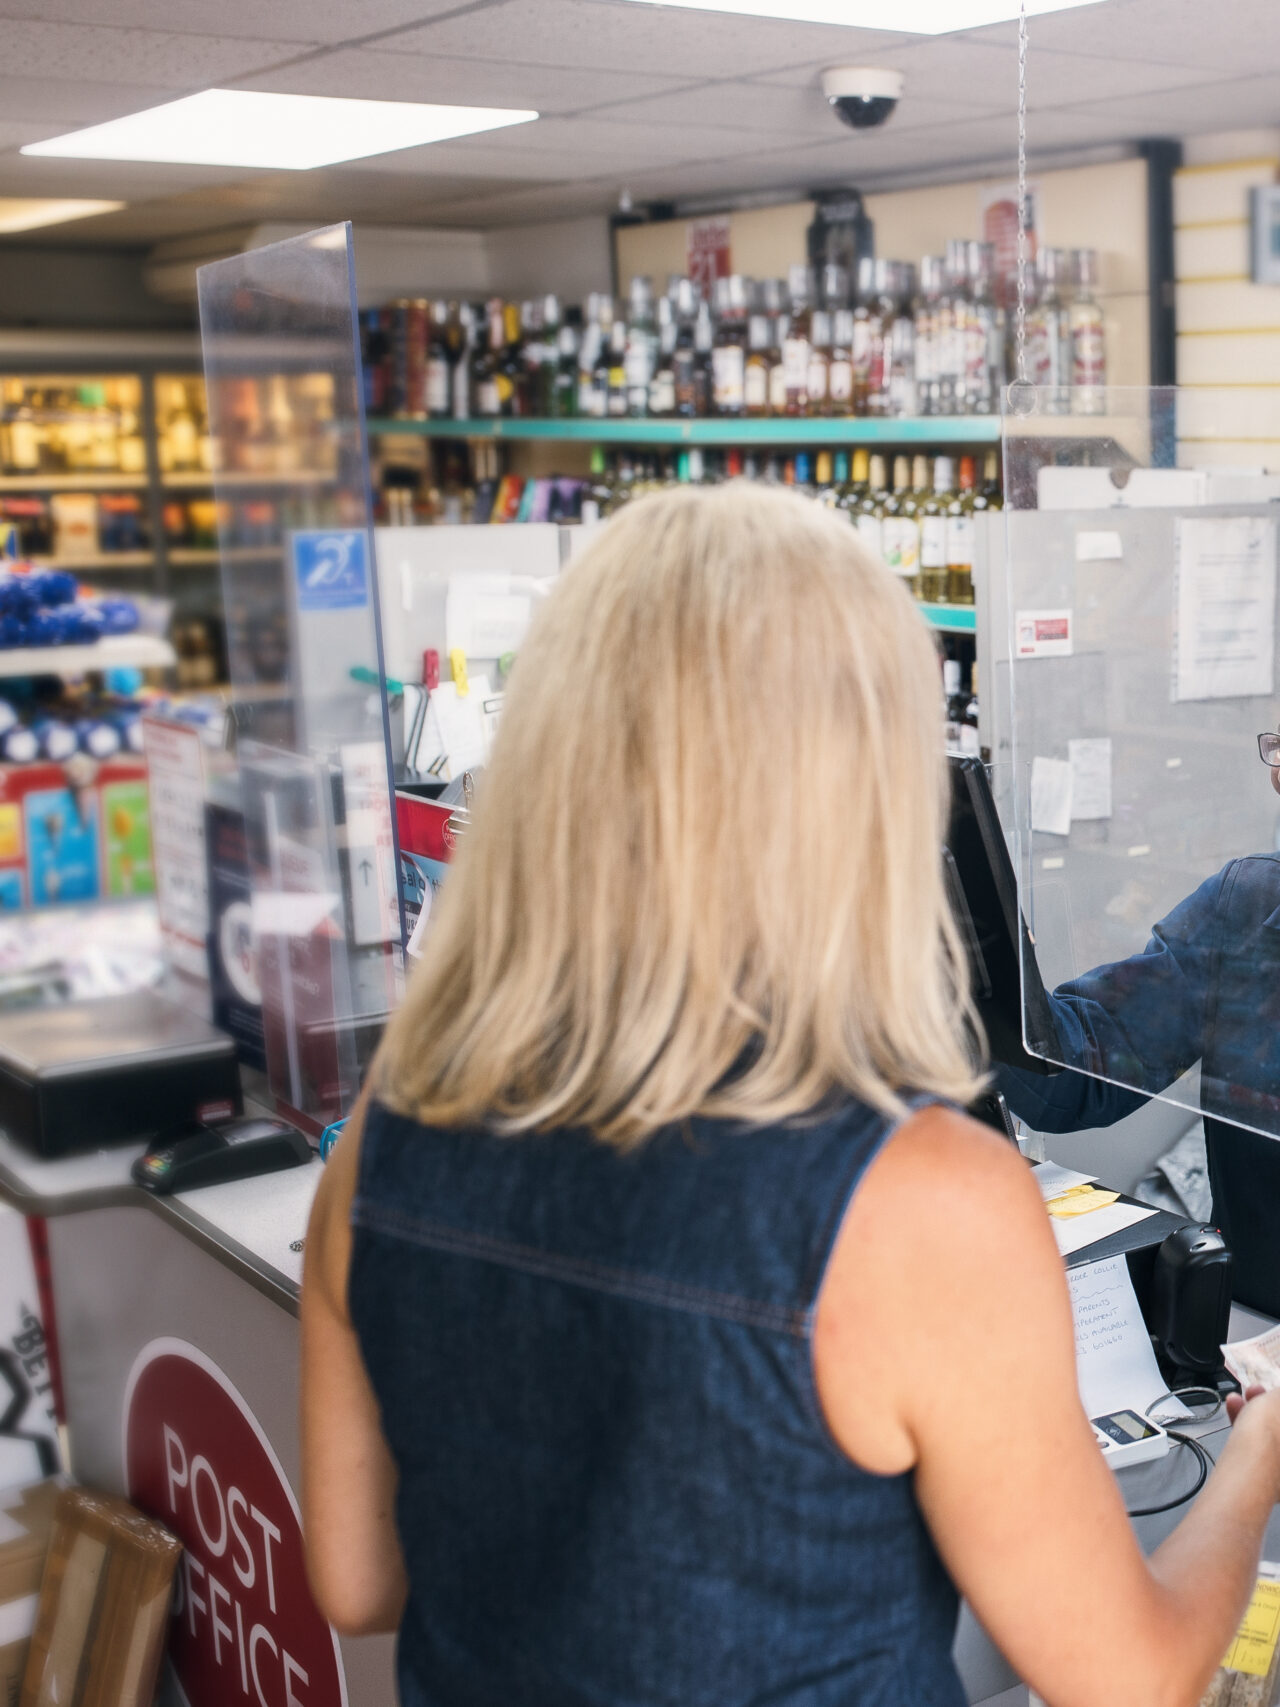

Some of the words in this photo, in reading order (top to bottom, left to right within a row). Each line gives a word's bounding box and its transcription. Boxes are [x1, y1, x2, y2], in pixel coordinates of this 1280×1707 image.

[1070, 1271, 1089, 1282] RDER
[1093, 1264, 1118, 1275] COLLIE
[1078, 1299, 1110, 1314] PARENTS
[1091, 1319, 1128, 1336] AVAILABLE
[163, 1421, 281, 1616] POST
